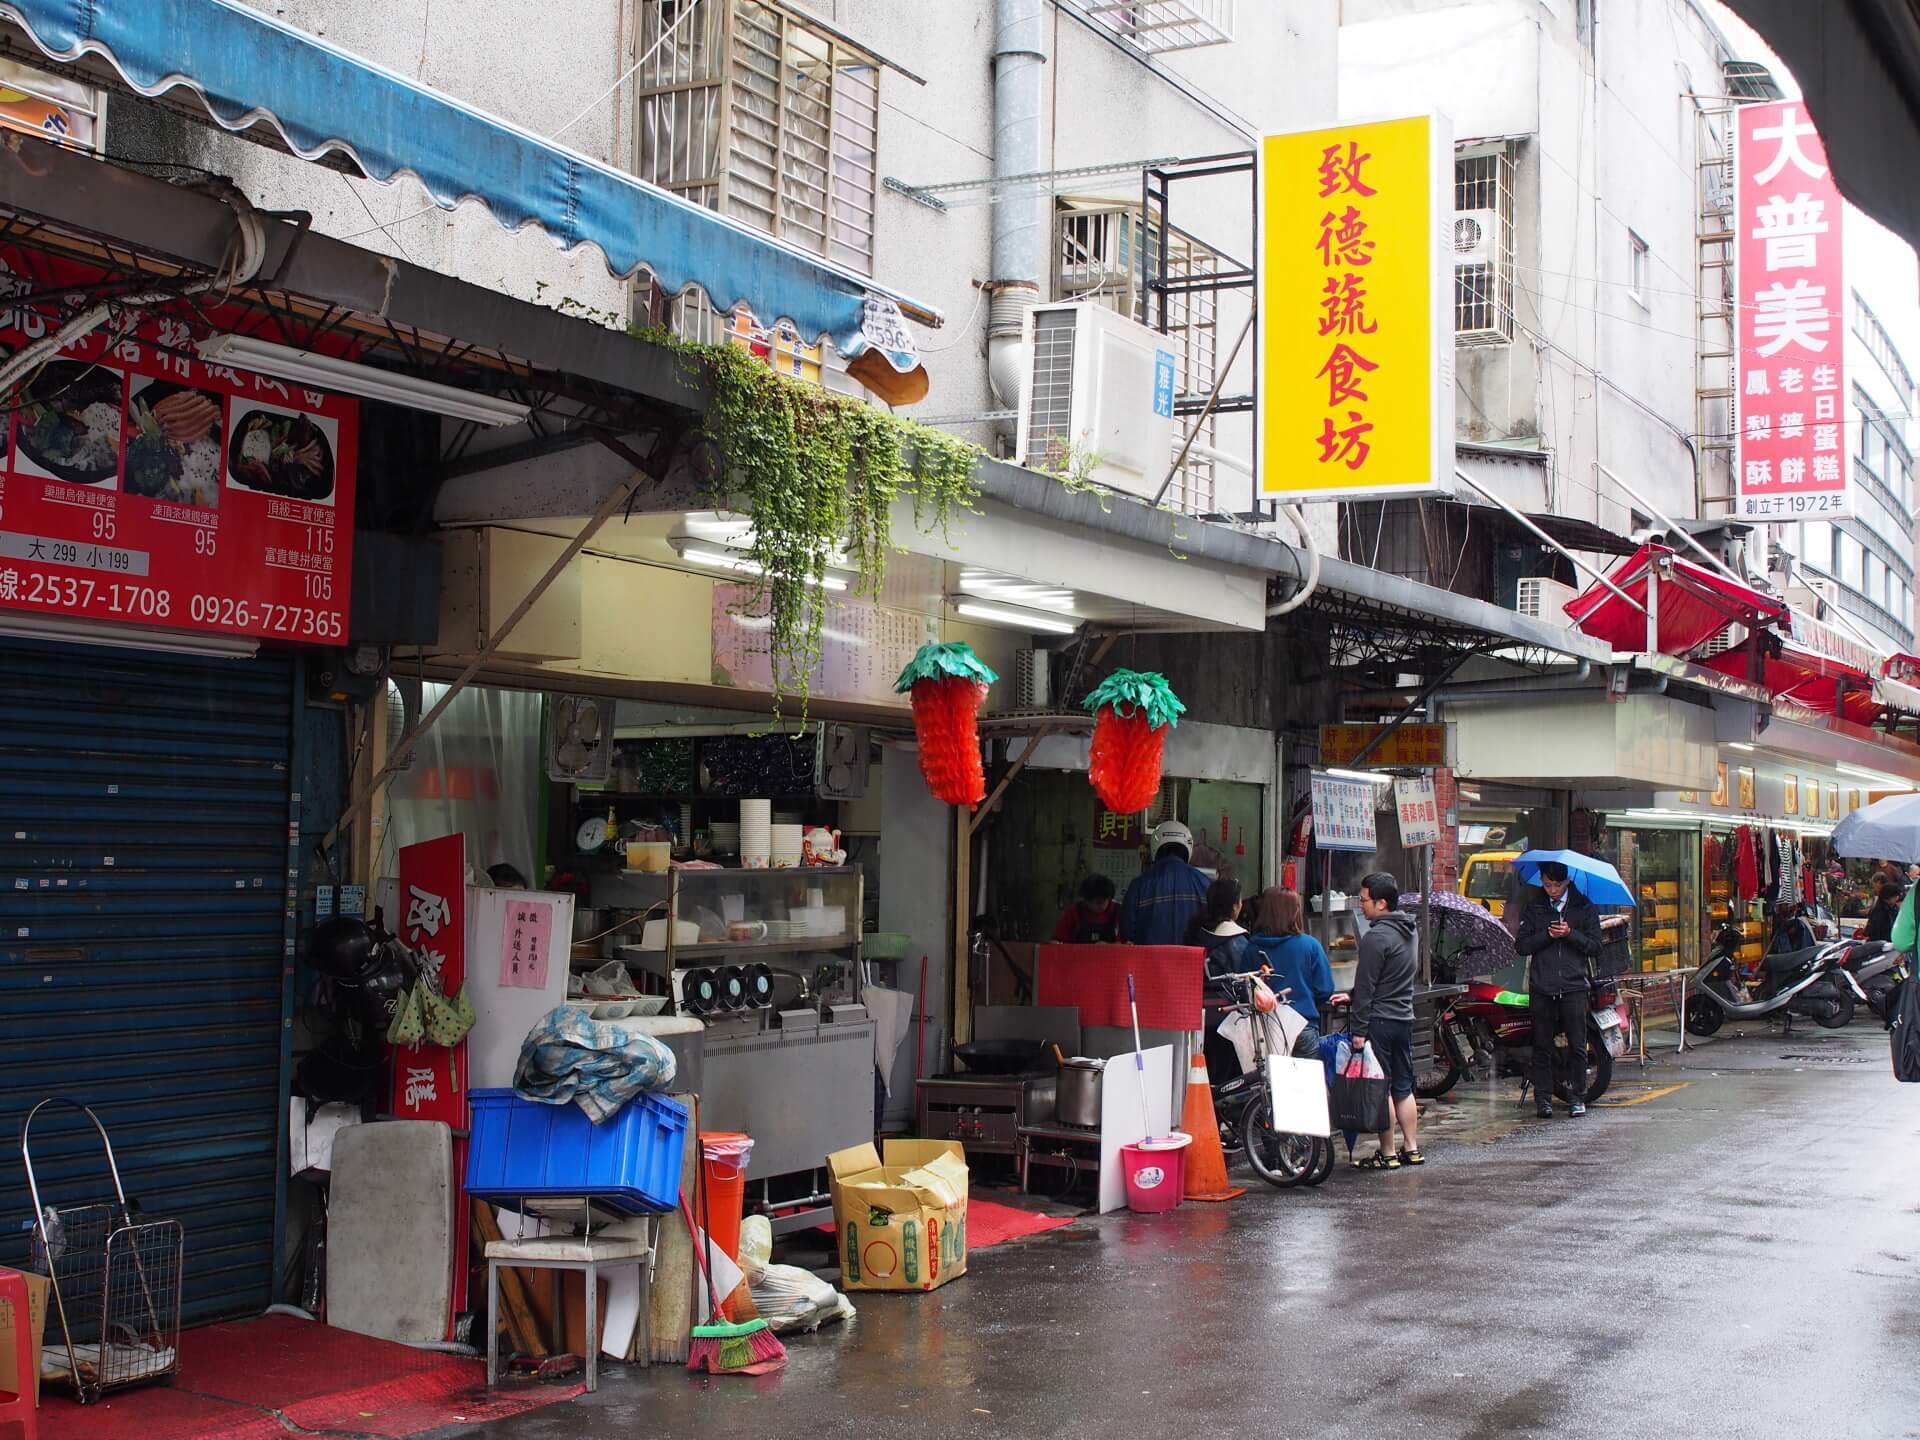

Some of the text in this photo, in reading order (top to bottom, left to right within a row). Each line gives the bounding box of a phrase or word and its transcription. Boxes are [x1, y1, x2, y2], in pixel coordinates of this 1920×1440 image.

[1751, 107, 1830, 358] 大普美
[1315, 140, 1380, 471] 致德蔬食坊
[1745, 369, 1773, 486] 鳳梨酥
[1778, 367, 1806, 484] 老婆餅
[1811, 364, 1840, 482] 生日蛋糕
[92, 511, 116, 541] 95
[267, 500, 336, 525] 頂級三寶便當
[28, 538, 129, 569] 大 299 小 199
[195, 529, 217, 556] 95
[306, 526, 334, 554] 115
[265, 546, 334, 571] 富貴雙拼便當
[304, 574, 332, 601] 105
[190, 594, 342, 638] 0926-727365
